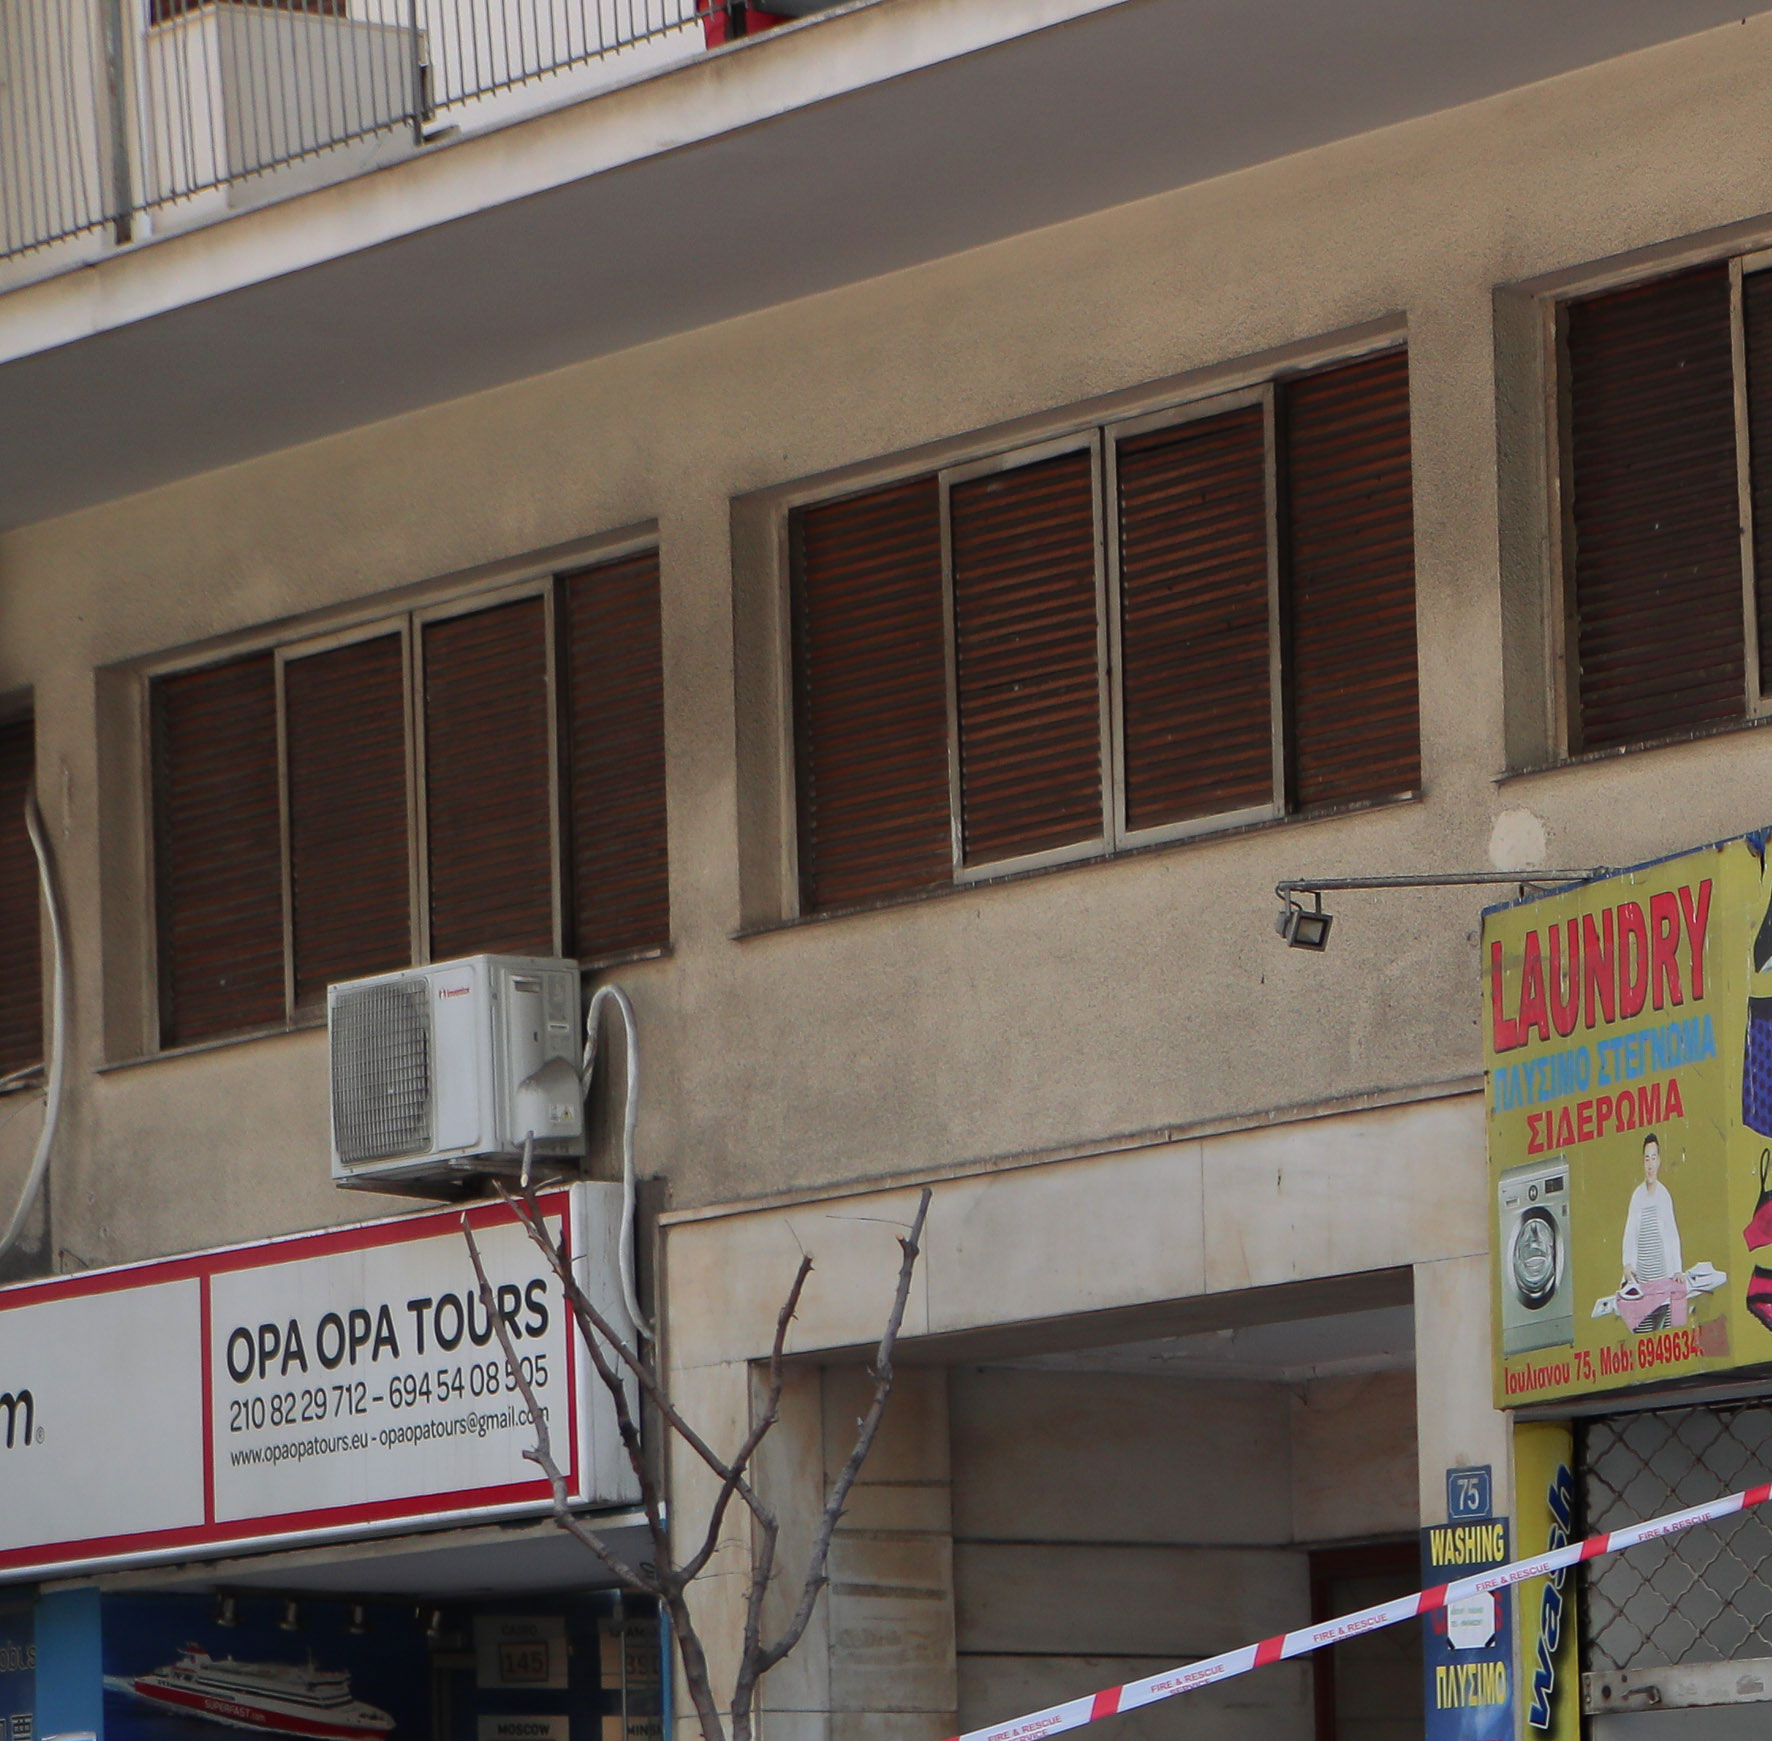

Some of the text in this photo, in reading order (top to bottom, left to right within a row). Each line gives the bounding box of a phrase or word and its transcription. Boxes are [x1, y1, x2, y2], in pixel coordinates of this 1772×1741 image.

[1490, 877, 1713, 1054] LAUNDRY
[1494, 1045, 1591, 1115] ΠΛΥΣΙΜΟ
[1526, 1078, 1685, 1155] ΣΙΔΕΡΩΜΑ
[226, 1277, 550, 1384] OPA OPA TOURS
[1573, 1350, 1597, 1384] 75,
[1599, 1344, 1635, 1376] Mob:
[1637, 1325, 1705, 1369] 6949634
[229, 1397, 266, 1432] 210
[270, 1392, 297, 1427] 82
[301, 1388, 328, 1424] 29
[332, 1381, 367, 1418] 712
[389, 1372, 433, 1410] 694
[437, 1367, 465, 1402] 54
[469, 1361, 500, 1398] 08
[504, 1353, 549, 1393] 505
[229, 1431, 369, 1468] www.opaopatours.eu
[1457, 1478, 1480, 1511] 75
[1430, 1524, 1505, 1566] WASHING
[1637, 1529, 1660, 1541] FIRE
[1671, 1512, 1712, 1531] RESCUE
[1475, 1578, 1498, 1591] FIRE
[1509, 1562, 1550, 1581] RESCUE
[1528, 1462, 1574, 1730] wash
[1312, 1629, 1335, 1642] FIRE
[1347, 1613, 1388, 1632] RESCUE
[1150, 1680, 1173, 1693] FIRE
[1183, 1663, 1225, 1682] RESCUE
[1435, 1659, 1506, 1709] ΠΛΥΣΙΜΟ
[497, 1724, 550, 1736] MOSCOW
[1021, 1714, 1063, 1734] RESCUE
